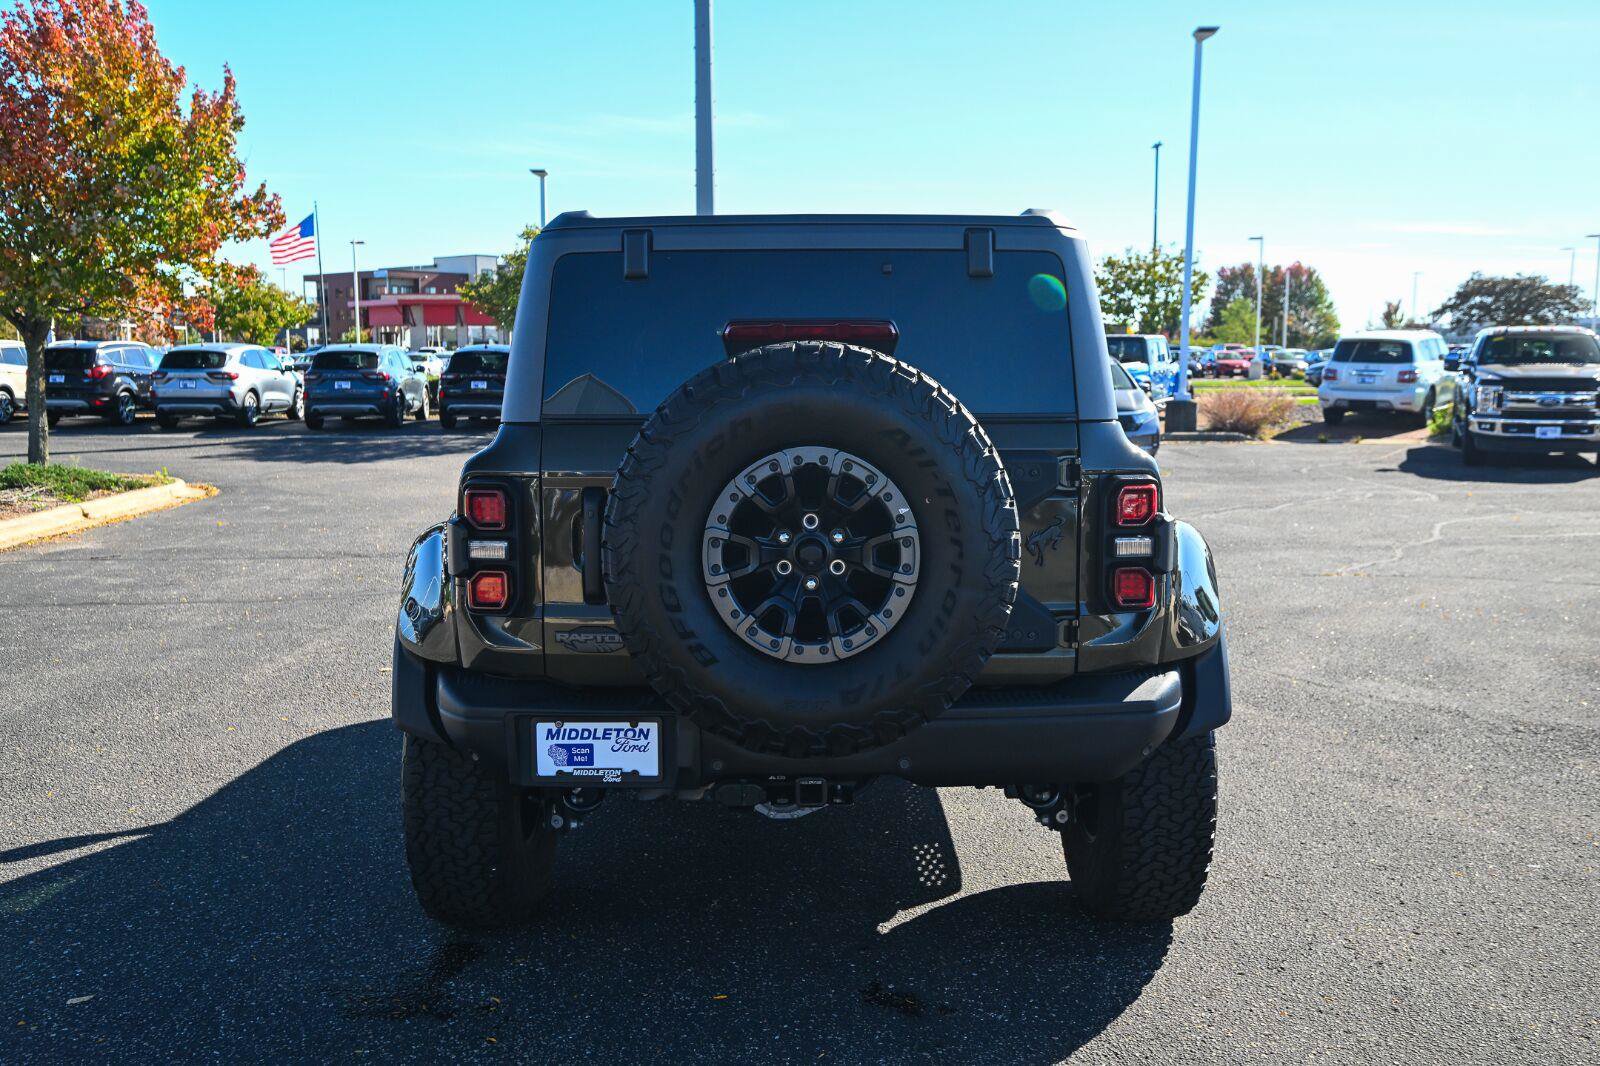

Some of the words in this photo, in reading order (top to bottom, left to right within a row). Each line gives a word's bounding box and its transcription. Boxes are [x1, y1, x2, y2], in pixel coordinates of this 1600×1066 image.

[657, 416, 753, 667] BFGoodrich
[546, 728, 650, 741] MIDDLETON
[611, 737, 650, 753] Ford
